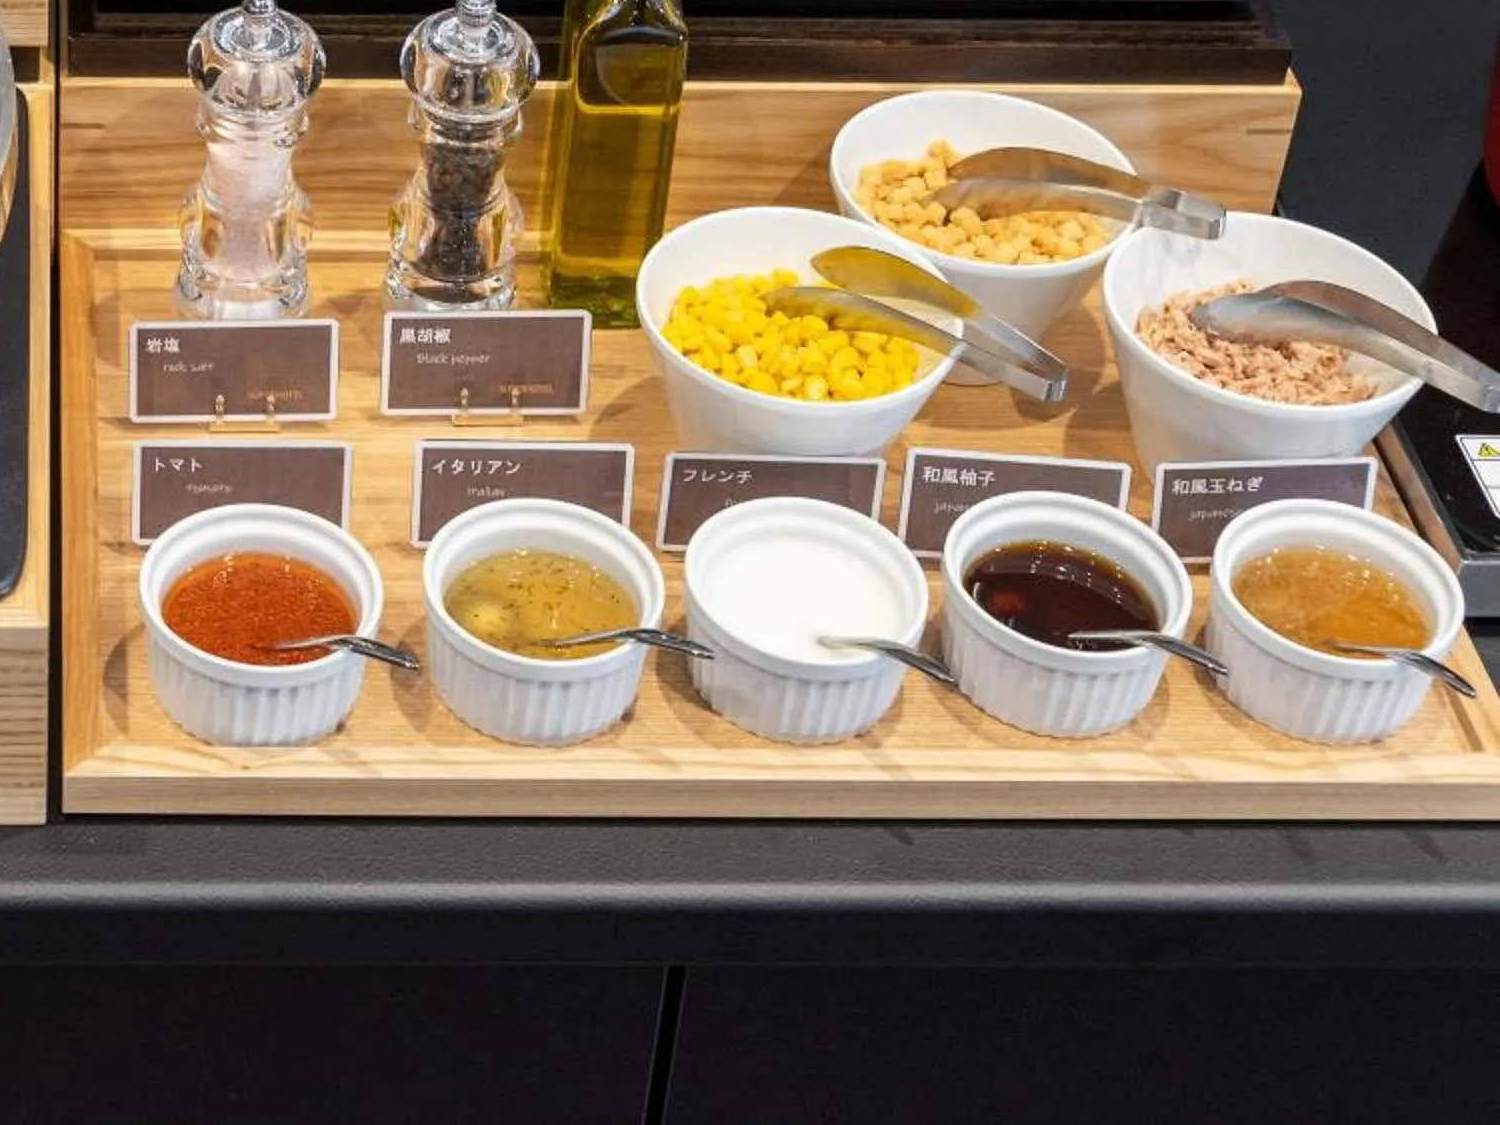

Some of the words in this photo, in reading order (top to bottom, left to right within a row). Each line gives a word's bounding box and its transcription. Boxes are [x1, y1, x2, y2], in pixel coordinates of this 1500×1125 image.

[400, 327, 451, 343] 黒胡椒
[146, 337, 181, 353] 岩塩
[154, 457, 203, 472] トマト
[432, 458, 521, 475] イタリアン
[683, 469, 753, 484] フレンチ
[923, 466, 997, 487] 和風柚子
[1172, 476, 1264, 495] 和風玉ねぎ
